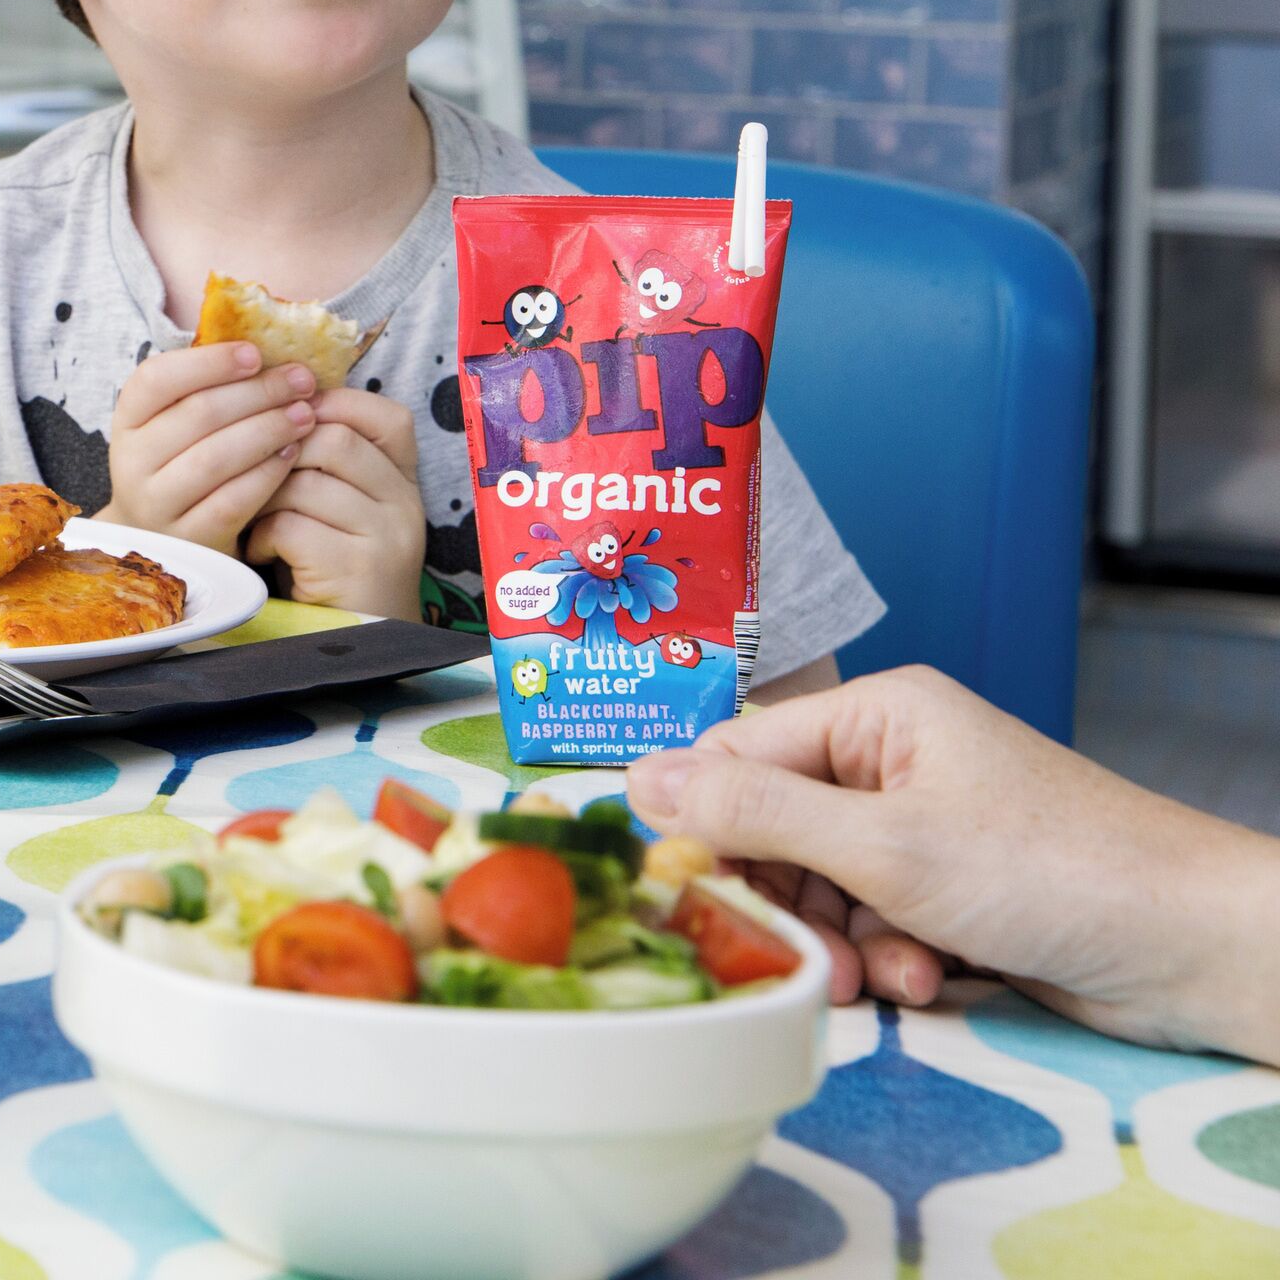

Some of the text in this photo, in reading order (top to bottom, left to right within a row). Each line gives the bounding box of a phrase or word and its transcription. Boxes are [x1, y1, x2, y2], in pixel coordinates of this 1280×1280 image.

[464, 326, 765, 488] pip
[497, 467, 722, 519] organic
[746, 566, 752, 582] me
[500, 585, 550, 596] no added
[743, 584, 753, 610] Keep
[508, 600, 540, 610] sugar
[549, 642, 656, 678] fruity
[564, 674, 641, 695] water
[521, 722, 696, 740] RASPBERRY & APPLE
[552, 742, 665, 756] with spring water
